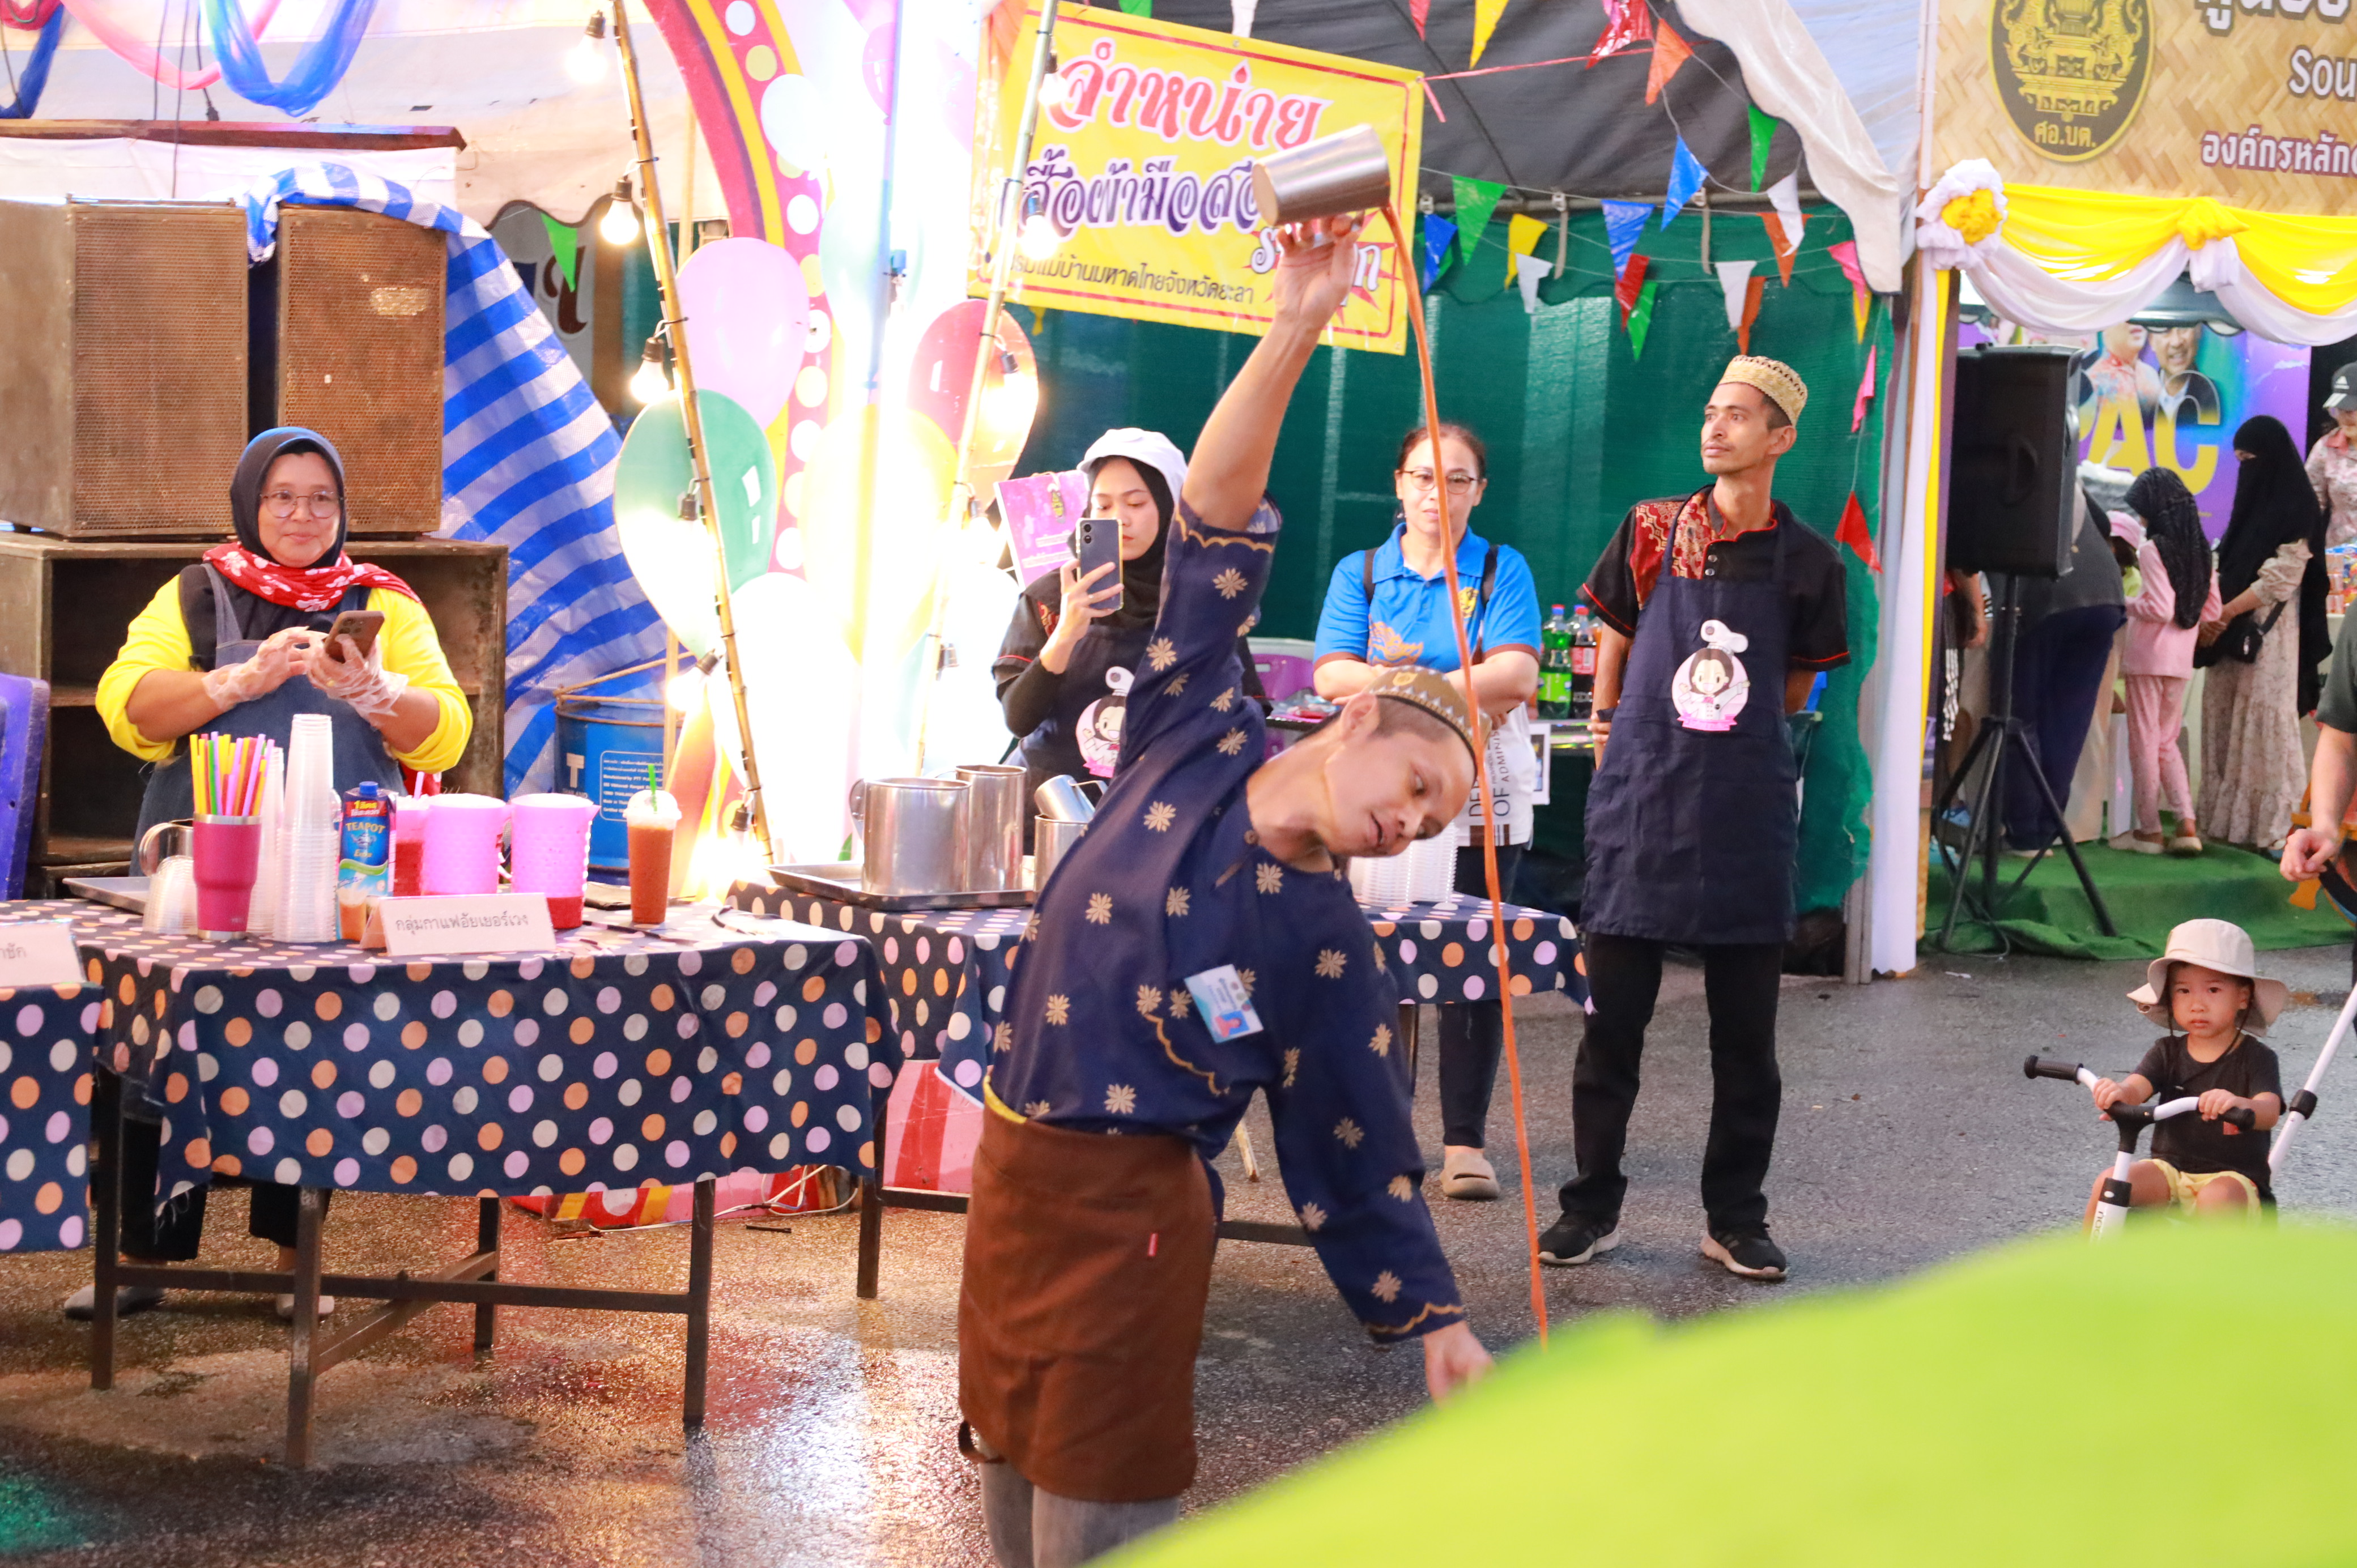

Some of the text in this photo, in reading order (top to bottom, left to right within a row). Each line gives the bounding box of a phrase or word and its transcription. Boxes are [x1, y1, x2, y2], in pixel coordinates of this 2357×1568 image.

[1048, 40, 1325, 151] จำหน่าย
[1493, 787, 1511, 817] OF
[345, 821, 386, 834] TEAPOT
